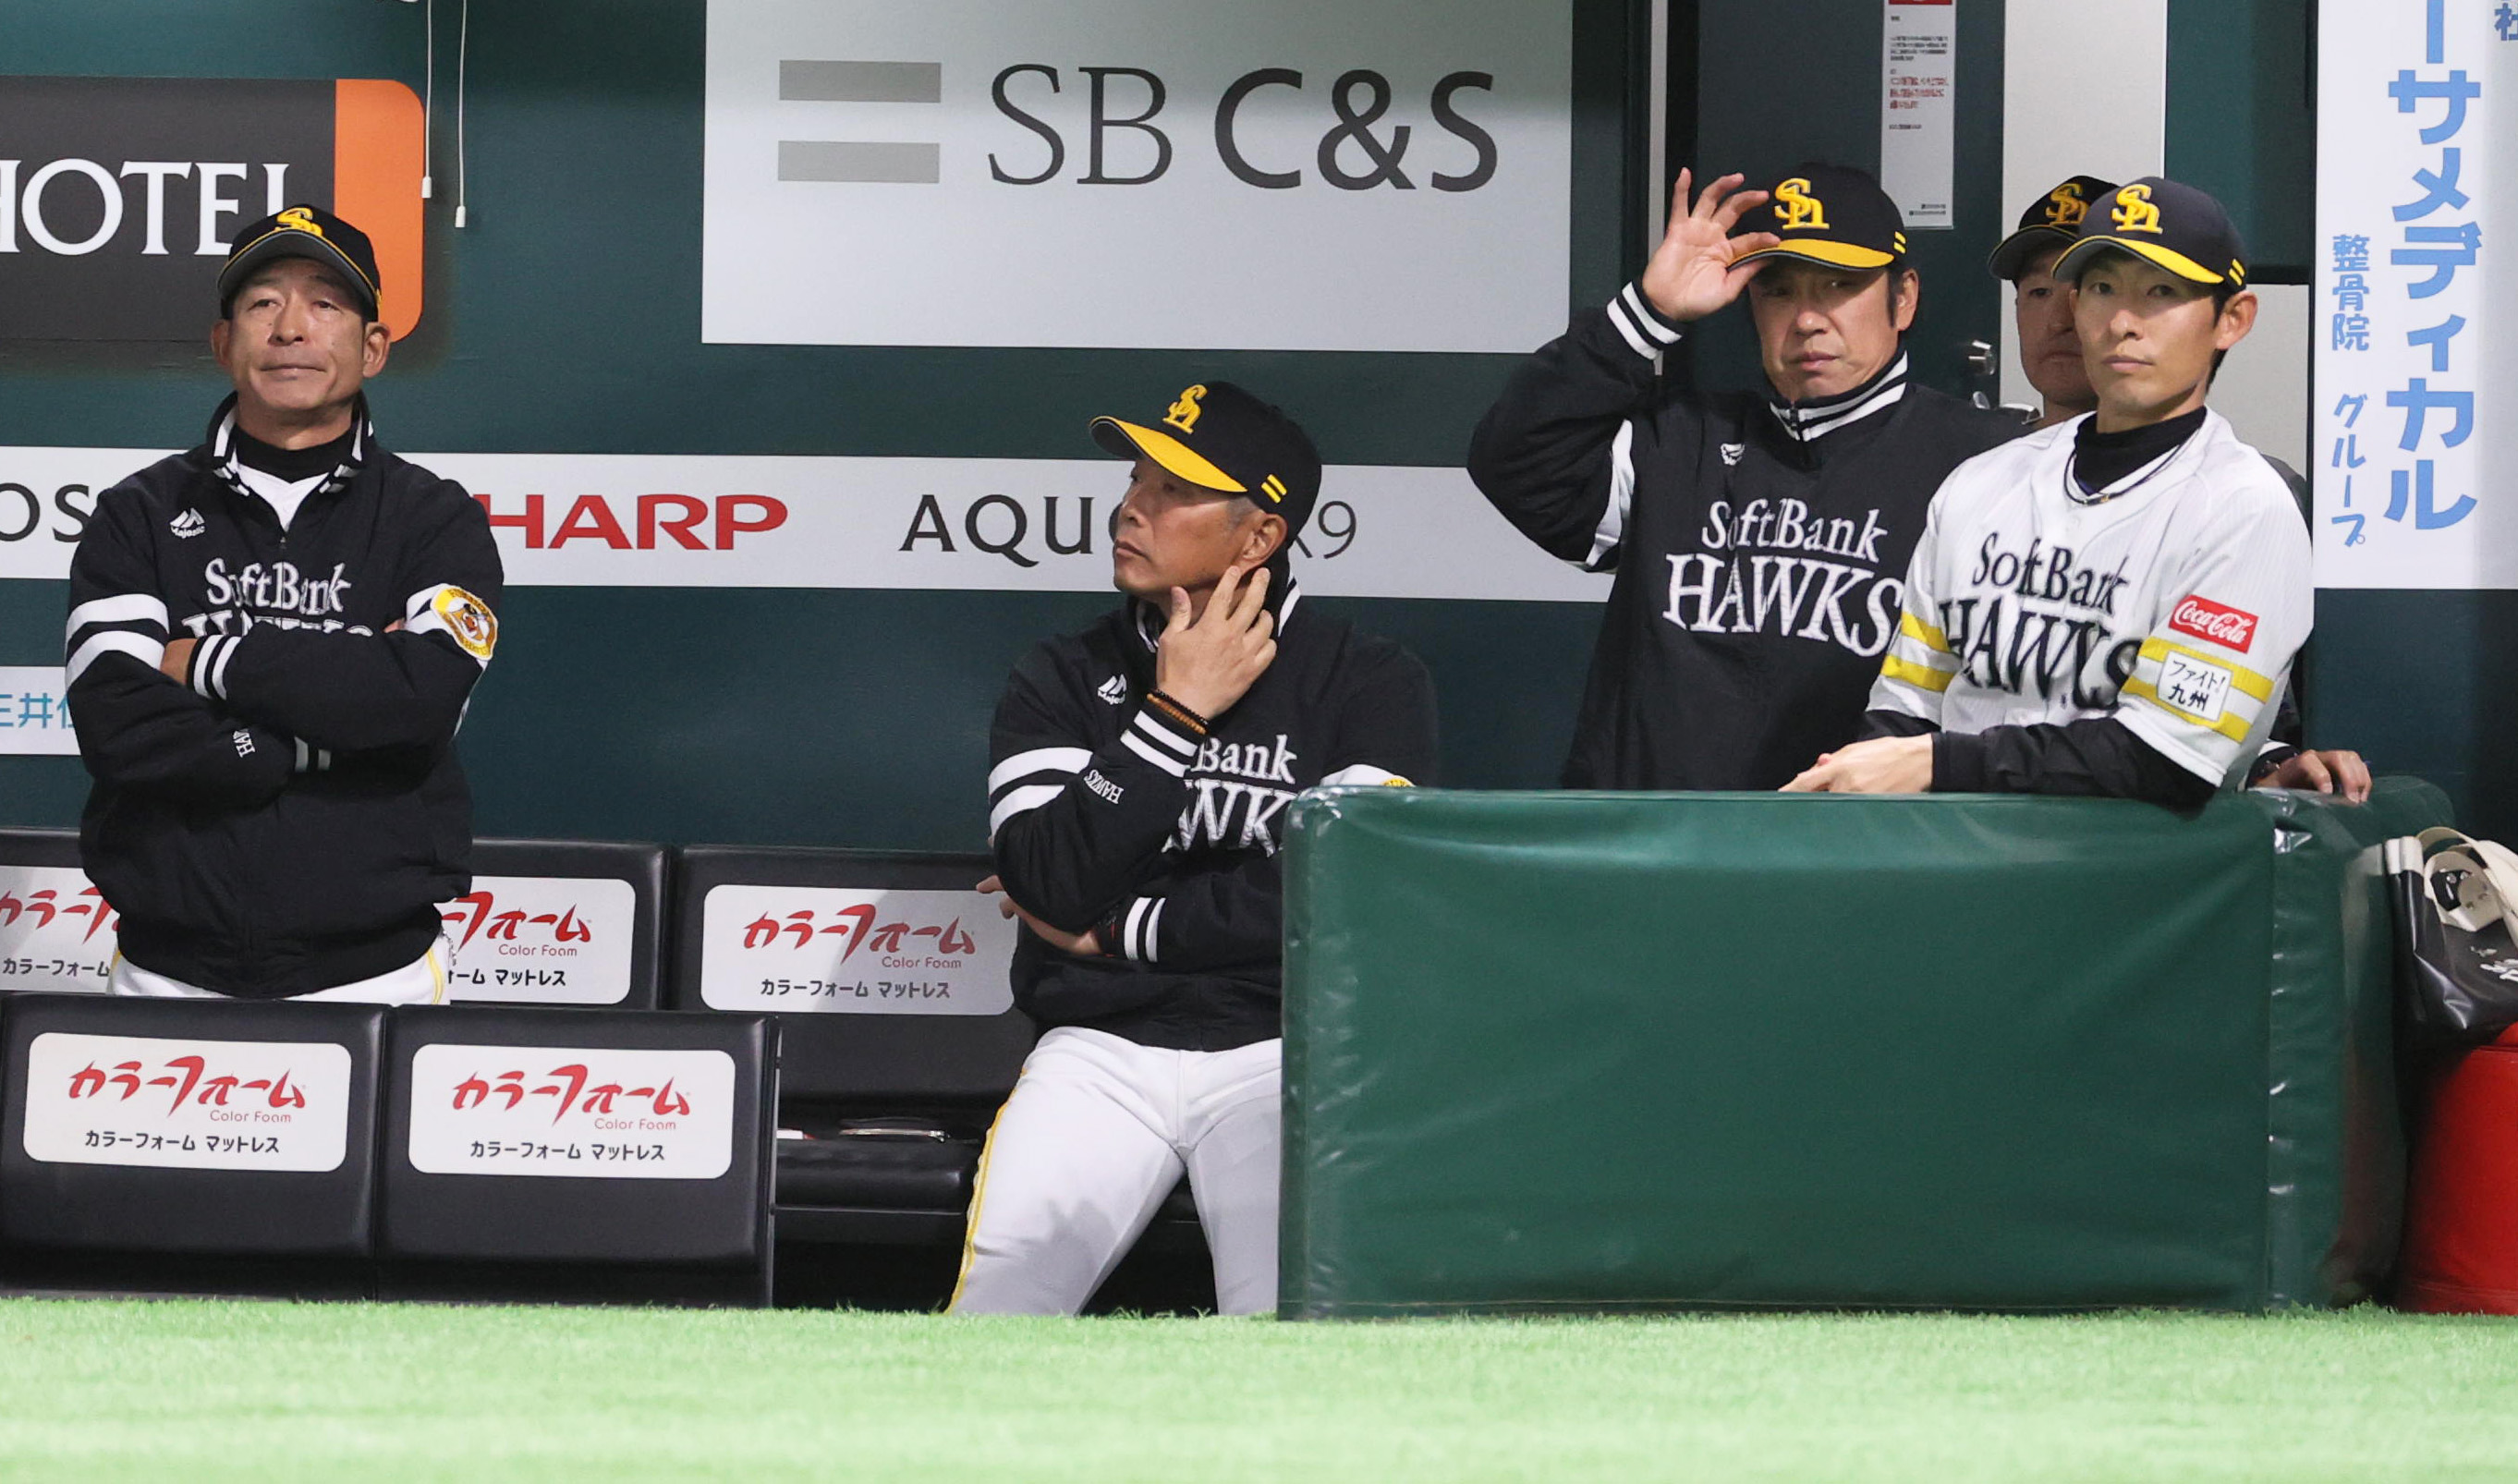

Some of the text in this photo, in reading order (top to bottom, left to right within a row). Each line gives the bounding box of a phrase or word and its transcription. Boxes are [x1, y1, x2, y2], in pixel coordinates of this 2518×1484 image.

[989, 64, 1498, 192] SB C&S
[2331, 394, 2367, 547] グループ
[899, 494, 1118, 567] AQU
[1702, 498, 1888, 564] SoftBank
[1662, 553, 1904, 657] HAWKS
[2168, 683, 2209, 712] 九州
[499, 944, 578, 957] Color Foam
[882, 956, 962, 969] Color Foam
[495, 968, 566, 986] マットレス
[760, 979, 950, 999] カラーフォーム マットレス
[210, 1110, 291, 1123] Color Foam
[594, 1117, 676, 1130] Color Foam
[85, 1130, 279, 1153] カラーフォーム マットレス
[470, 1140, 665, 1162] カラーフォーム マットレス
